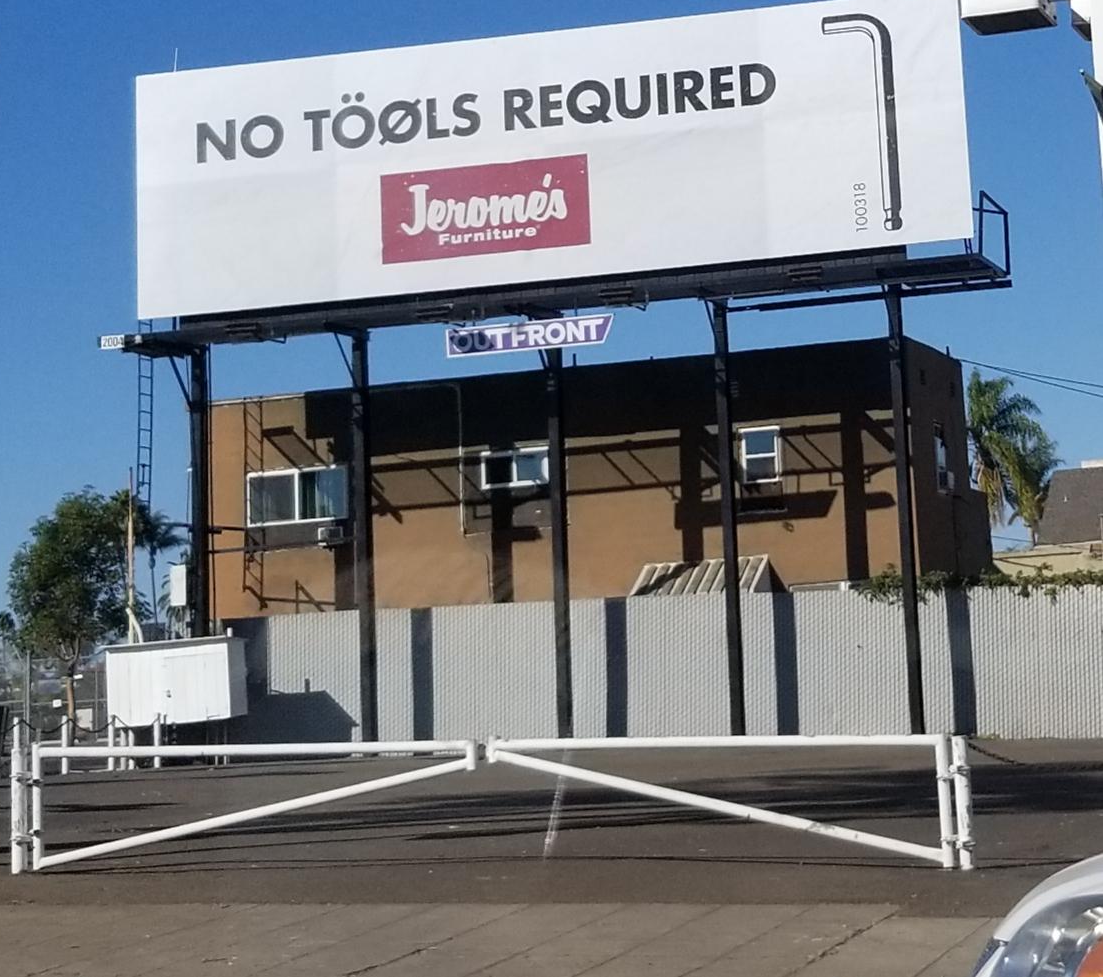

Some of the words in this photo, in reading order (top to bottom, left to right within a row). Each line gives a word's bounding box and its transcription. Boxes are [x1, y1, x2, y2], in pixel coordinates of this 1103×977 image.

[196, 114, 285, 164] NO
[303, 91, 482, 152] TÖØLS
[503, 62, 777, 131] REQUIRED
[400, 173, 568, 236] Jerome's
[853, 182, 868, 232] 100318
[438, 225, 538, 246] Furniture
[452, 318, 605, 353] OUTFRONT
